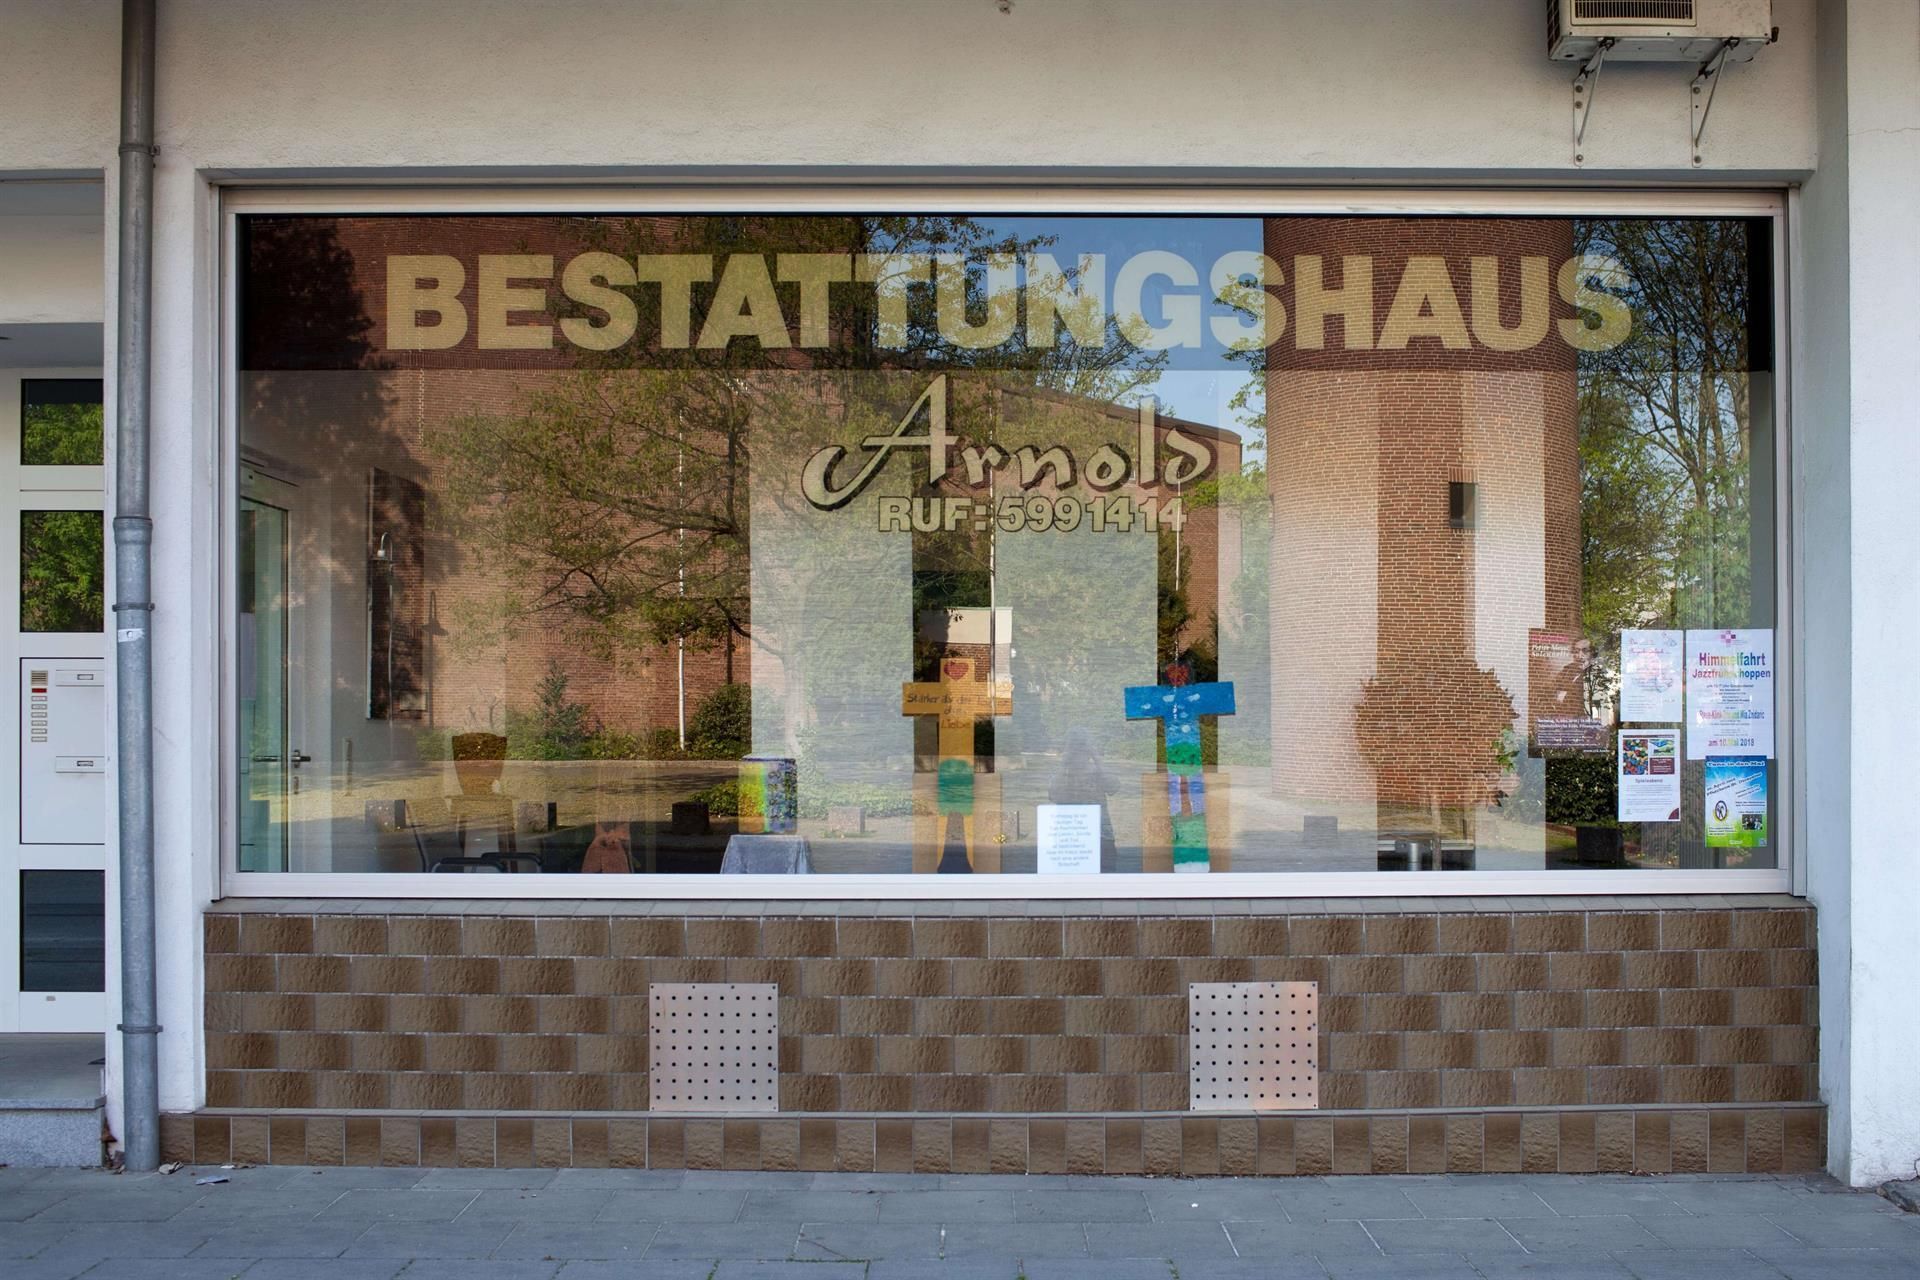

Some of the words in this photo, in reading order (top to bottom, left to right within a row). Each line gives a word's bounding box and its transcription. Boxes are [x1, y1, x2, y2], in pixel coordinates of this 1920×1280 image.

[385, 250, 1633, 353] BESTATTUNGSHAUS
[801, 370, 1218, 512] Arnold
[878, 496, 988, 533] RUF:
[1699, 652, 1766, 666] Himmelfahrt
